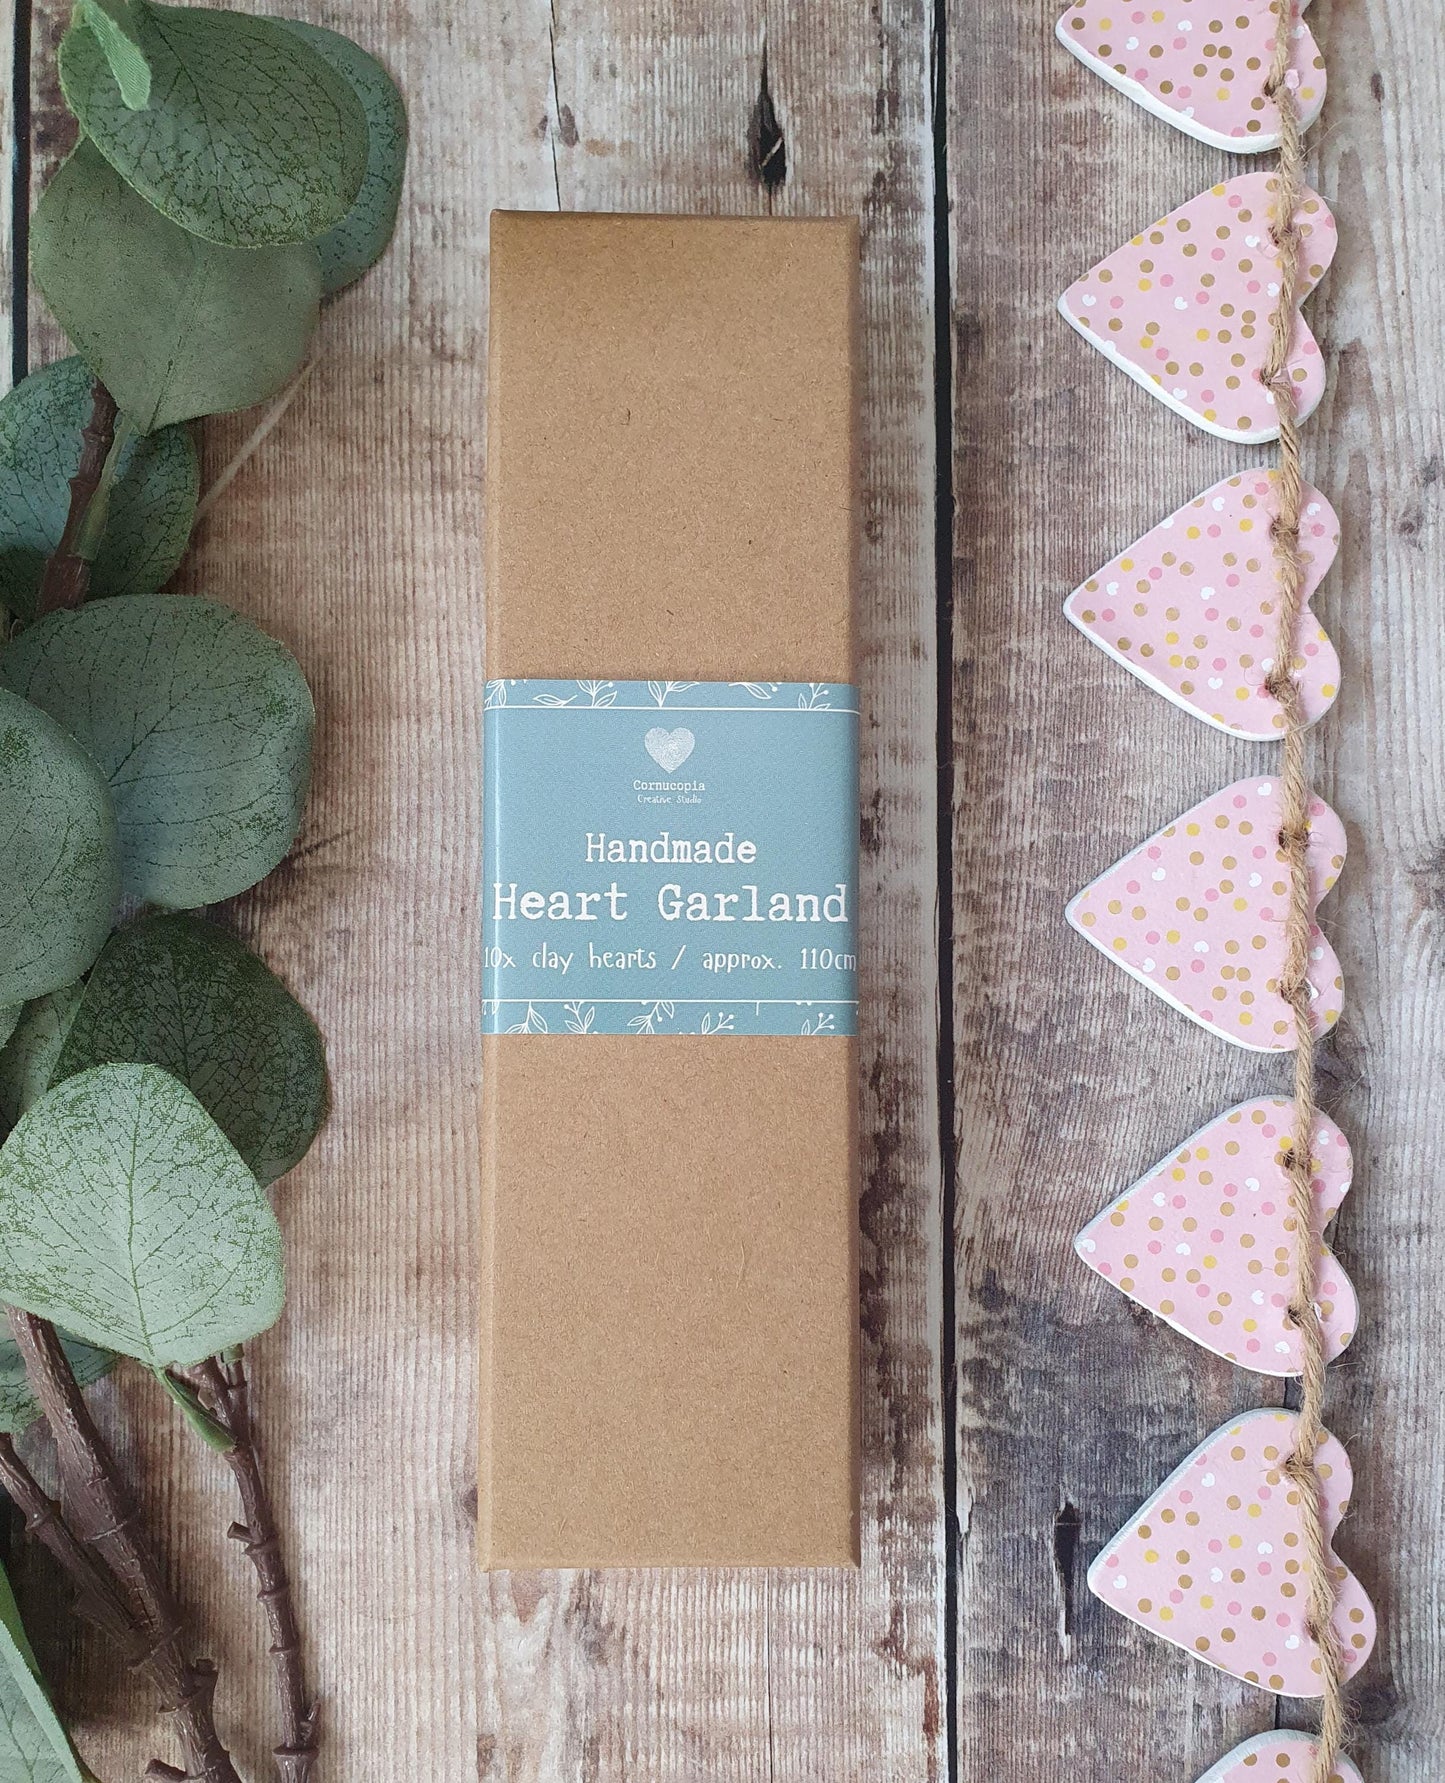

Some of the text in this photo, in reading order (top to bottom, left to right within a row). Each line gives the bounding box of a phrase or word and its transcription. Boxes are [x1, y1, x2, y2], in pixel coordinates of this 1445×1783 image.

[633, 779, 705, 793] Cornucopia
[637, 794, 702, 804] Creative Studio
[585, 831, 757, 864] Handmade
[492, 882, 849, 923] Heart Garland
[483, 942, 857, 975] 10x clay hearts / approx. 110cm
